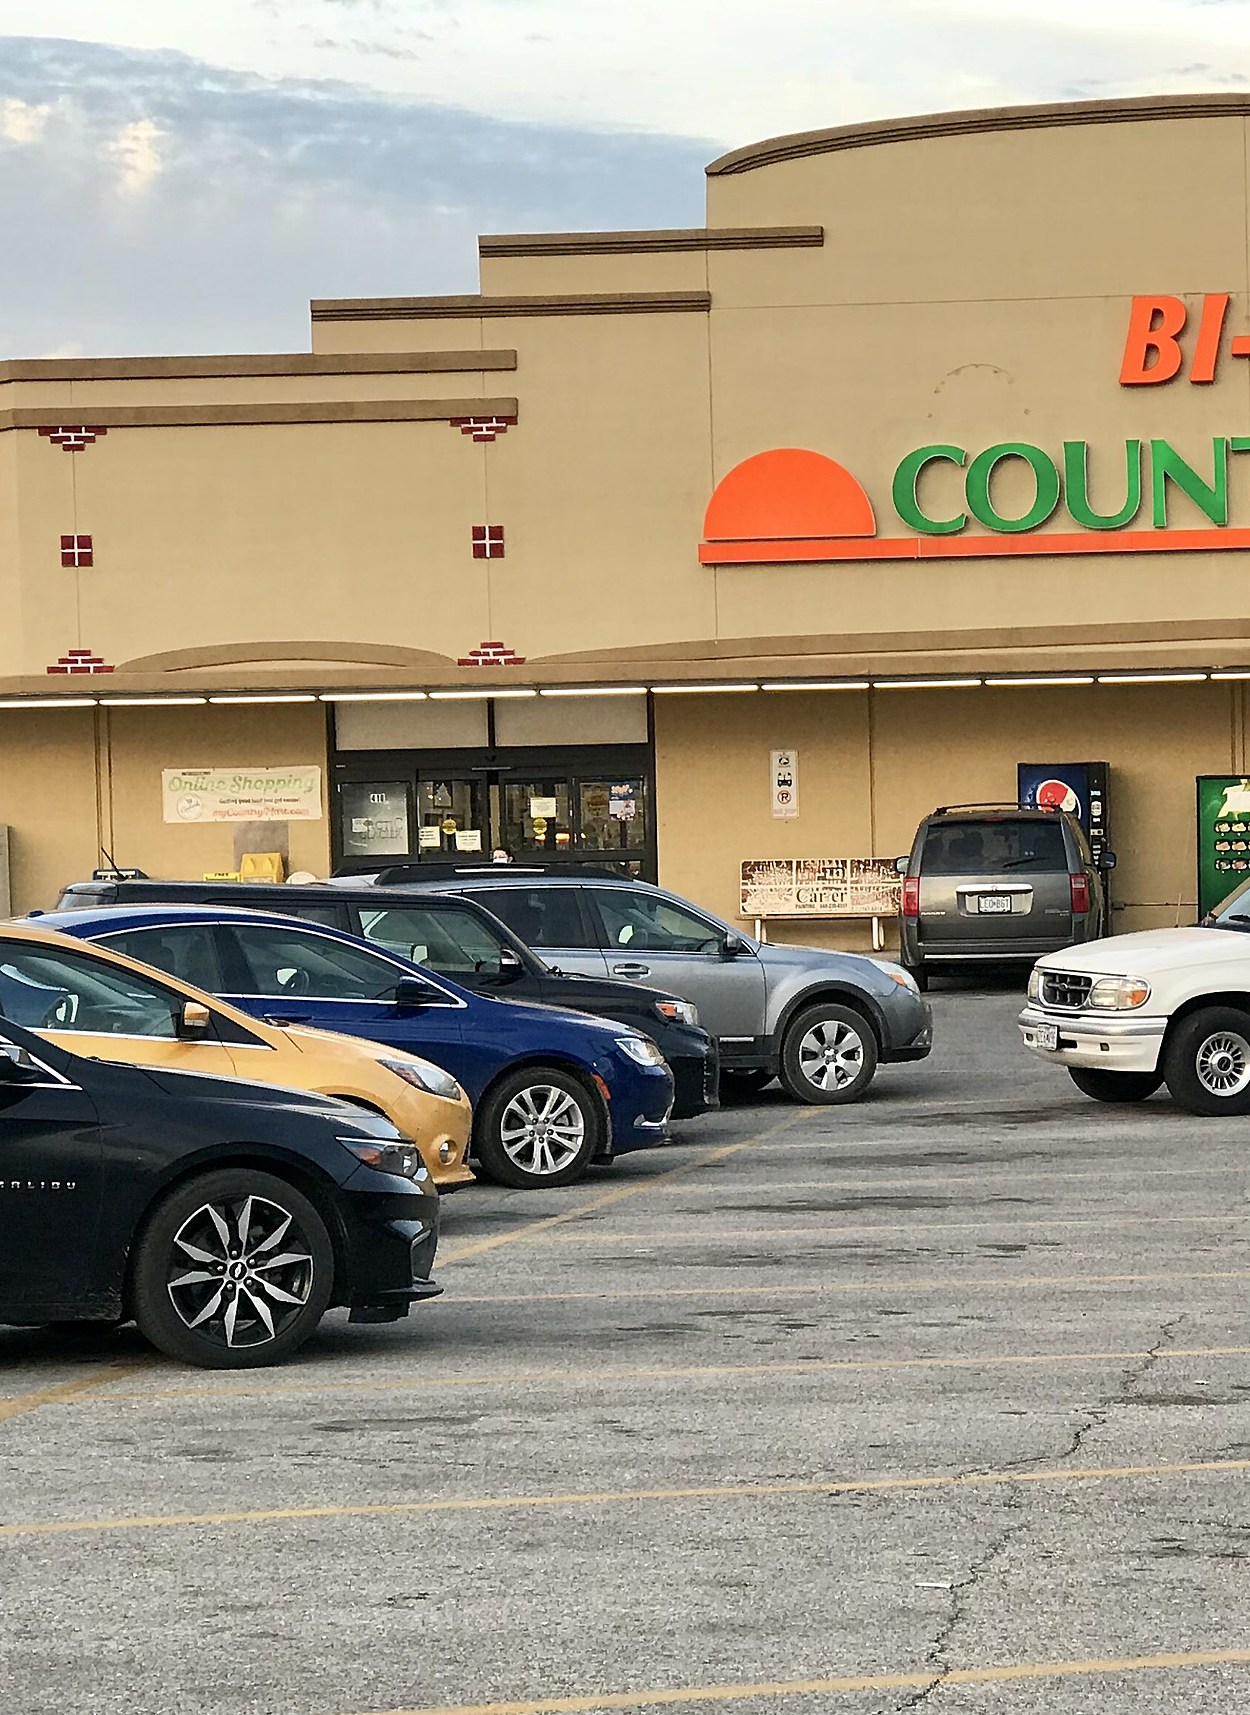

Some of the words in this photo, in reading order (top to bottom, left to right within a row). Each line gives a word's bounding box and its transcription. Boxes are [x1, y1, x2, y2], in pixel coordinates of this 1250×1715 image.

[168, 776, 227, 792] Online
[229, 775, 314, 794] Shopping
[796, 888, 848, 904] Carer
